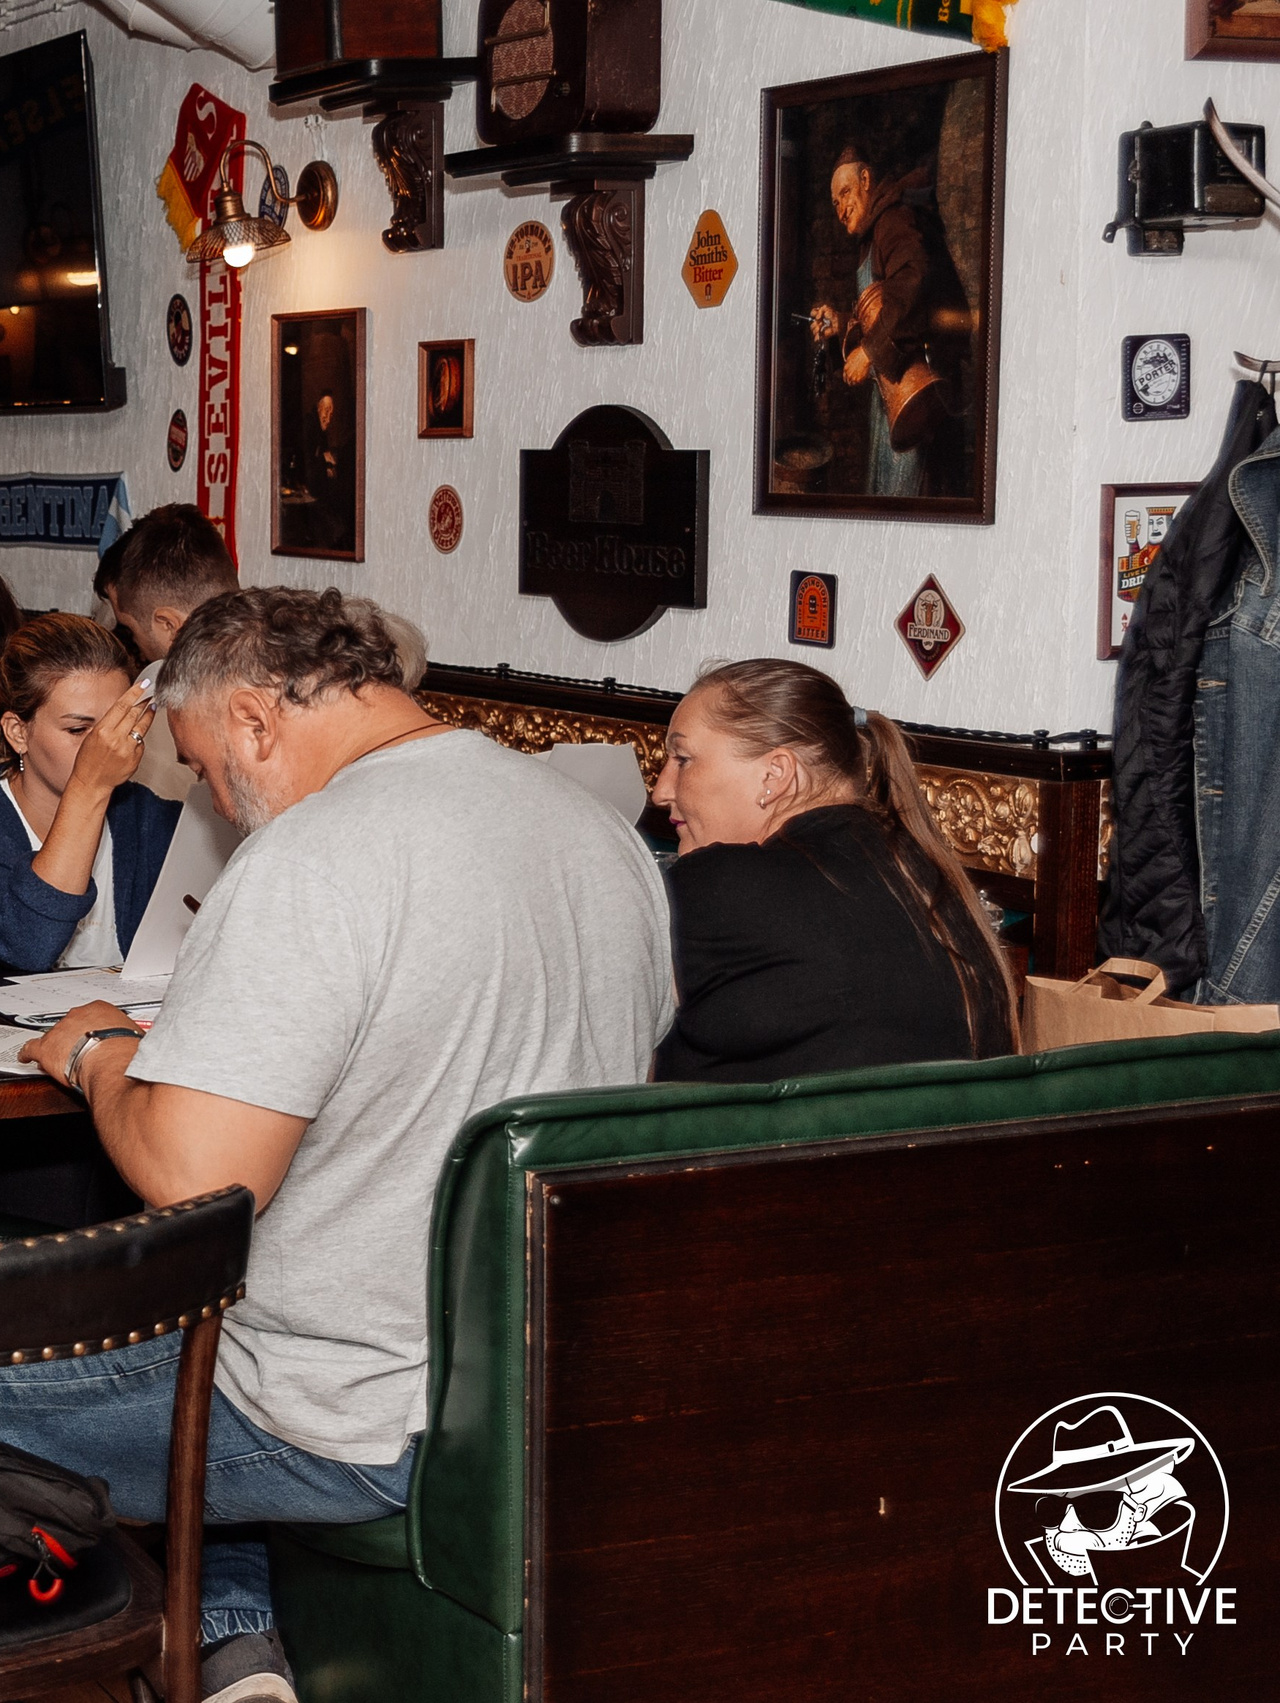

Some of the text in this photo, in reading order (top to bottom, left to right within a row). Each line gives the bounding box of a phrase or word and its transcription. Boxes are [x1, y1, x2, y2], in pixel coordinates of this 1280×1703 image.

[695, 230, 721, 250] John
[689, 245, 728, 267] Smith's
[512, 261, 546, 292] IPA
[693, 266, 724, 284] Bitter
[1138, 359, 1177, 386] PORTER
[1123, 568, 1140, 579] LIVE
[797, 627, 826, 638] BITTER
[908, 623, 950, 640] FERDINAND
